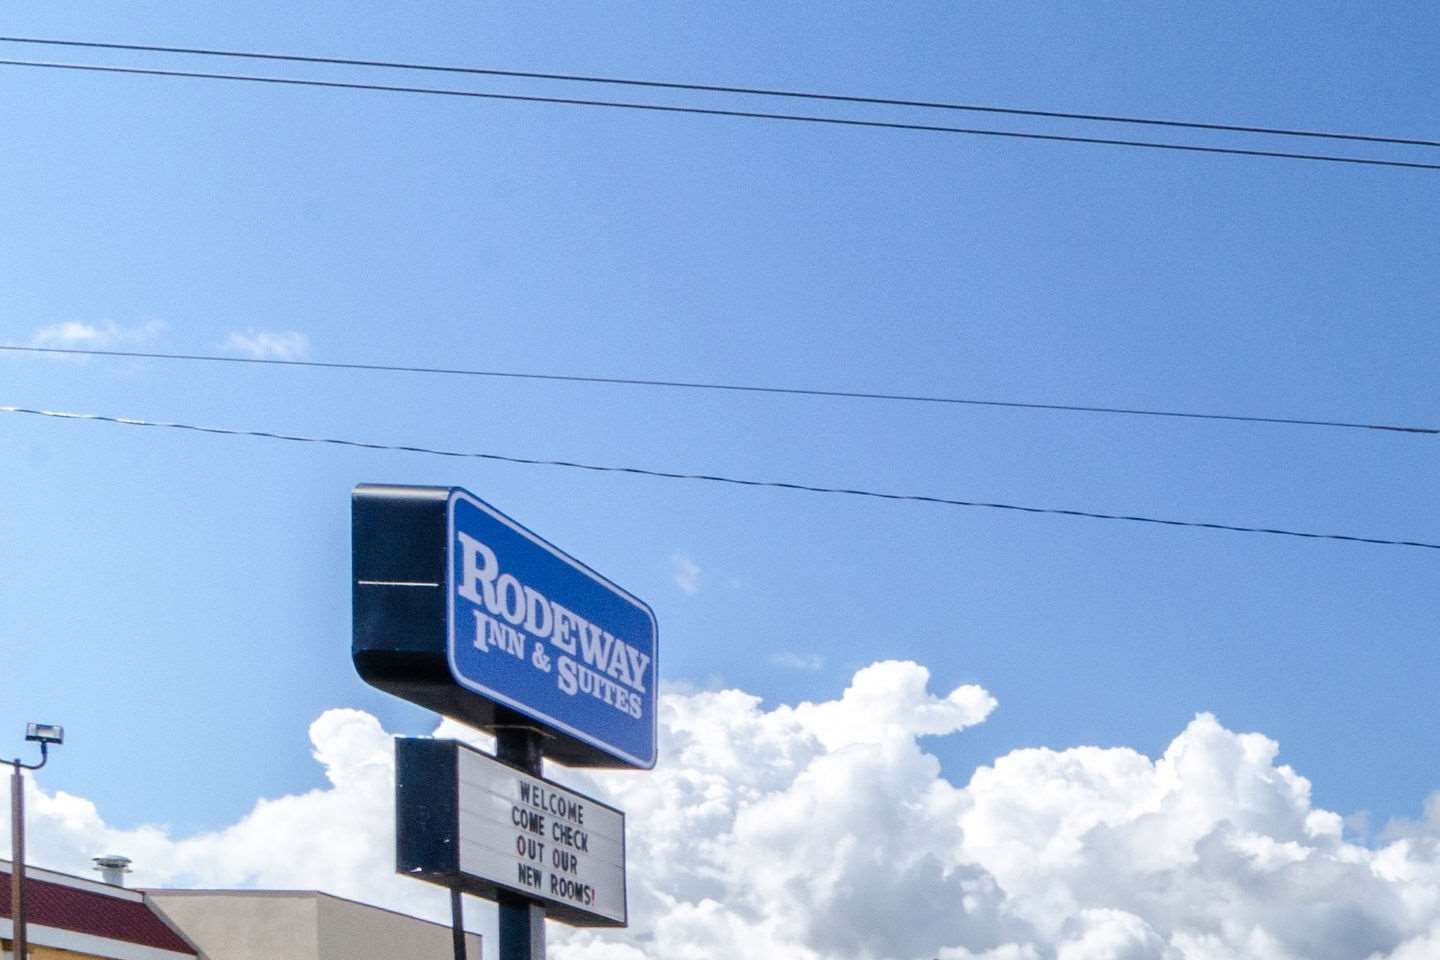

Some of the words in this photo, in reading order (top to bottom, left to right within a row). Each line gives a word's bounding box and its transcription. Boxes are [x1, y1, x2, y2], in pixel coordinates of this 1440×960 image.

[458, 531, 650, 693] RODEWAY
[473, 610, 526, 661] INN
[531, 643, 551, 673] &
[558, 655, 642, 719] SUITES
[520, 780, 584, 825] WELCOME
[512, 805, 545, 836] COME
[552, 822, 589, 852] CHECK
[517, 835, 544, 862] OUT
[553, 849, 578, 875] OUR
[518, 863, 542, 889] NEW
[551, 874, 596, 906] ROOMS!
